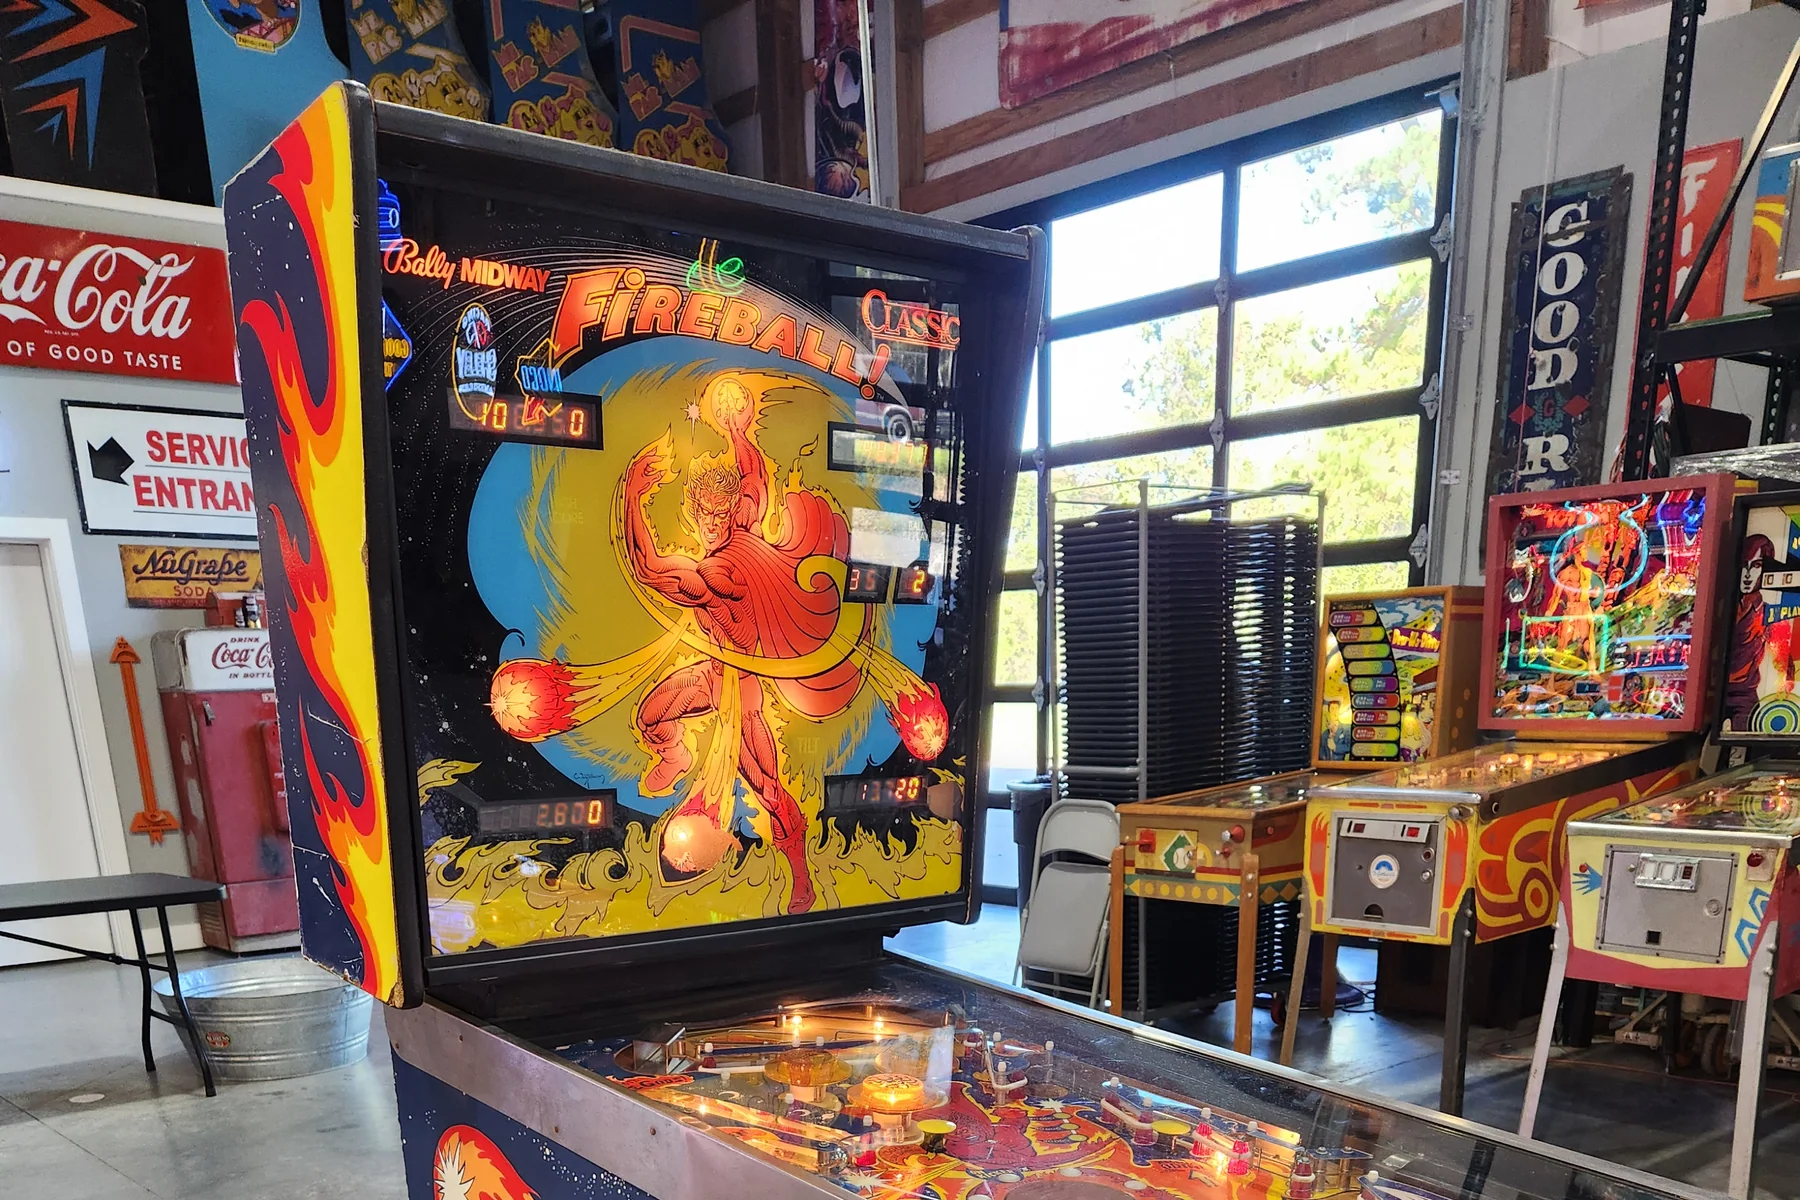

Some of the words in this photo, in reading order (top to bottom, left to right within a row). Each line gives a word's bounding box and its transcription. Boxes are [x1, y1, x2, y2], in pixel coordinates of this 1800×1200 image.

[384, 238, 456, 290] Bally
[461, 257, 551, 293] MIDWAY
[0, 243, 196, 339] a-Cola
[861, 288, 961, 347] CLASSIC
[7, 340, 36, 357] OF
[49, 344, 114, 364] GOOD
[123, 351, 183, 371] TASTE
[132, 550, 247, 585] NuGrape
[174, 585, 214, 597] SODA
